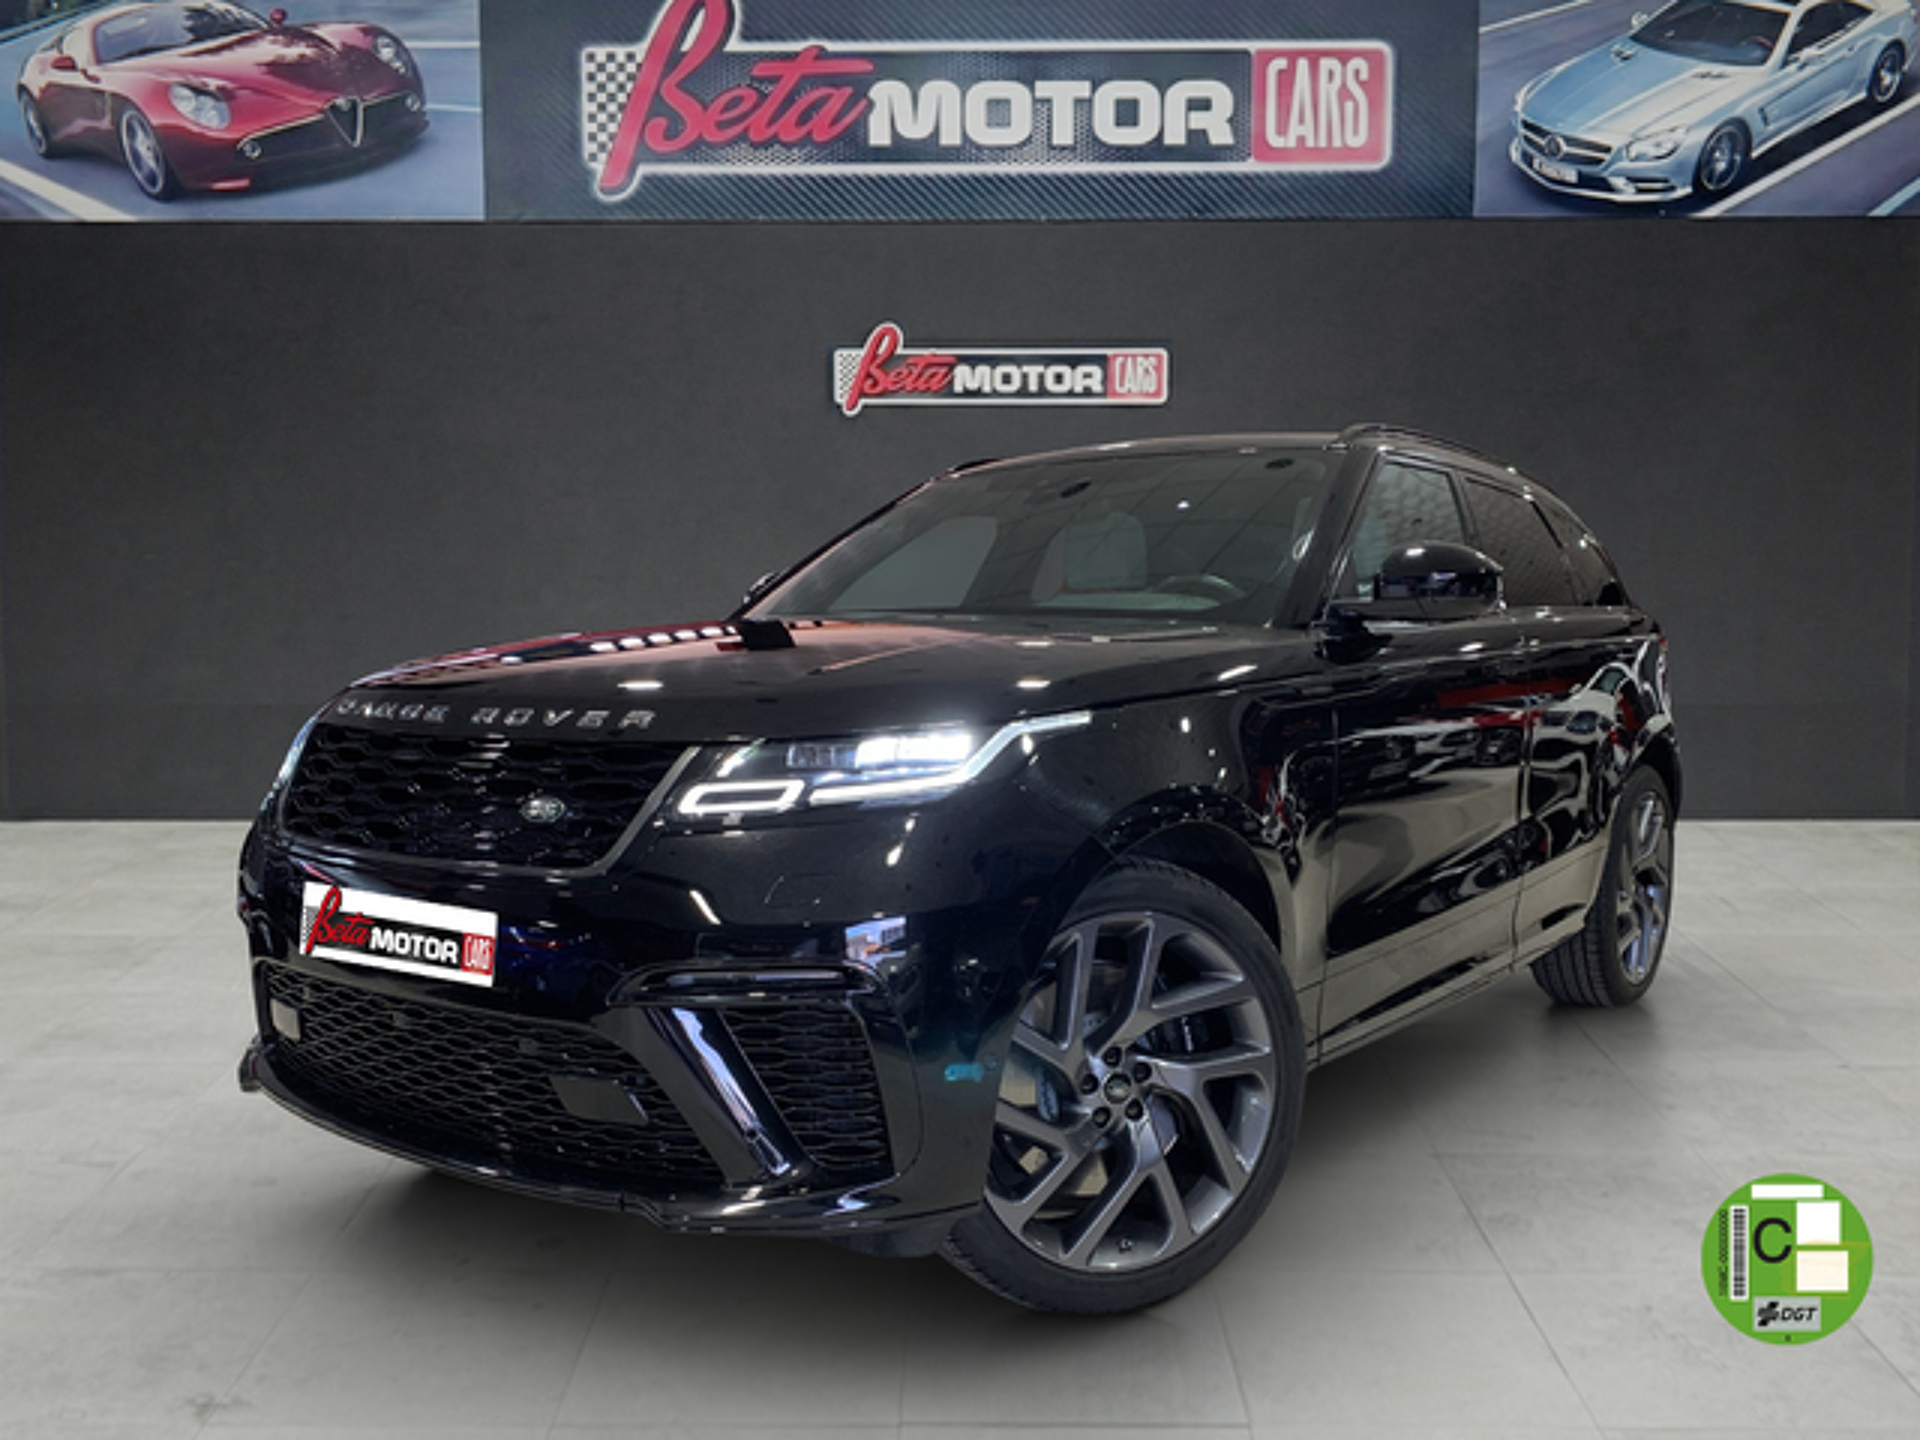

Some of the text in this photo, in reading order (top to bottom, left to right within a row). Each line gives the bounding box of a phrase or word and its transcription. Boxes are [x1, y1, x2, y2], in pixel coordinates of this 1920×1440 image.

[598, 0, 1369, 189] Beta MOTOR CARS
[845, 326, 1159, 411] Beta MOTOR CARS
[470, 707, 656, 728] ROVER
[304, 886, 491, 970] Beta MOTOR CARS
